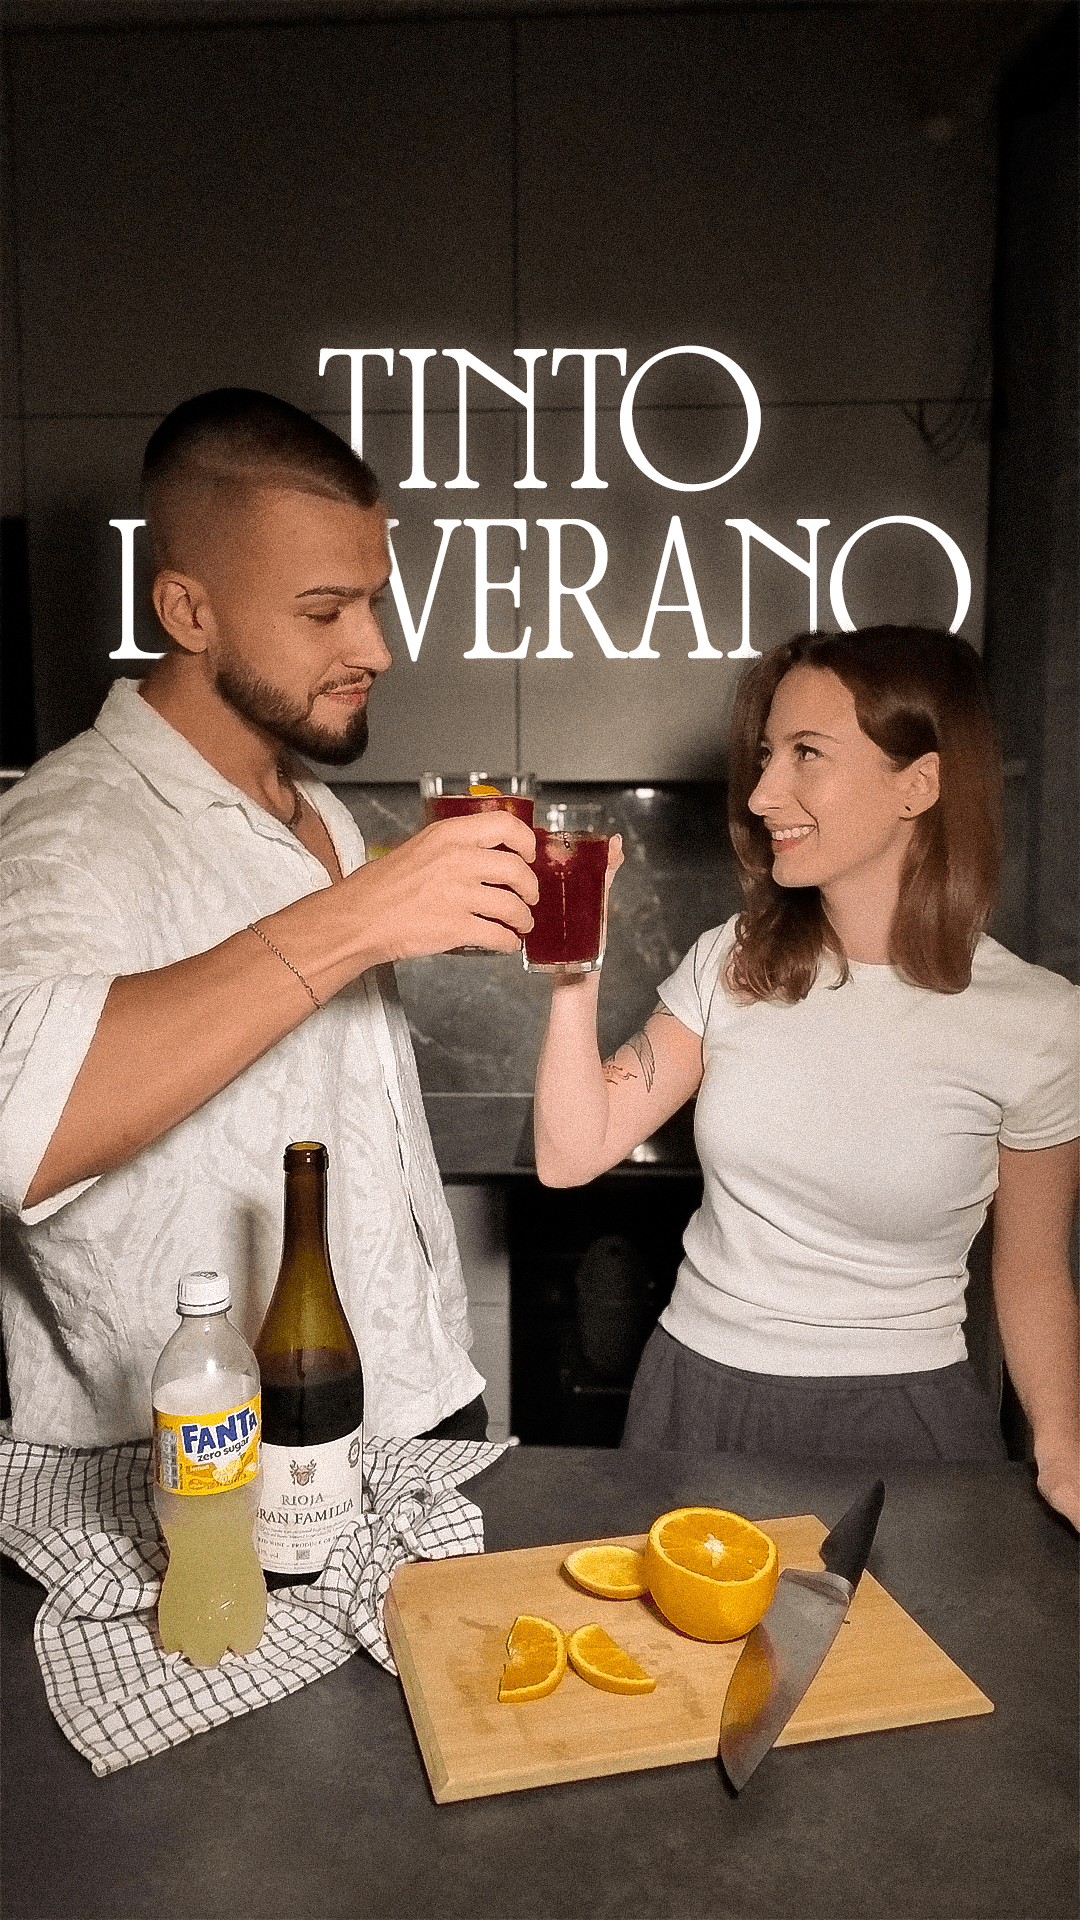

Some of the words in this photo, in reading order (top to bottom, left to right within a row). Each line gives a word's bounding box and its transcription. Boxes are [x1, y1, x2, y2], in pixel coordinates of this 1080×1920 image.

[181, 1407, 258, 1454] FANTA
[197, 1449, 222, 1462] zero
[223, 1436, 250, 1455] sugar
[281, 1493, 324, 1506] RIOJA
[294, 1498, 354, 1525] FAMILIA
